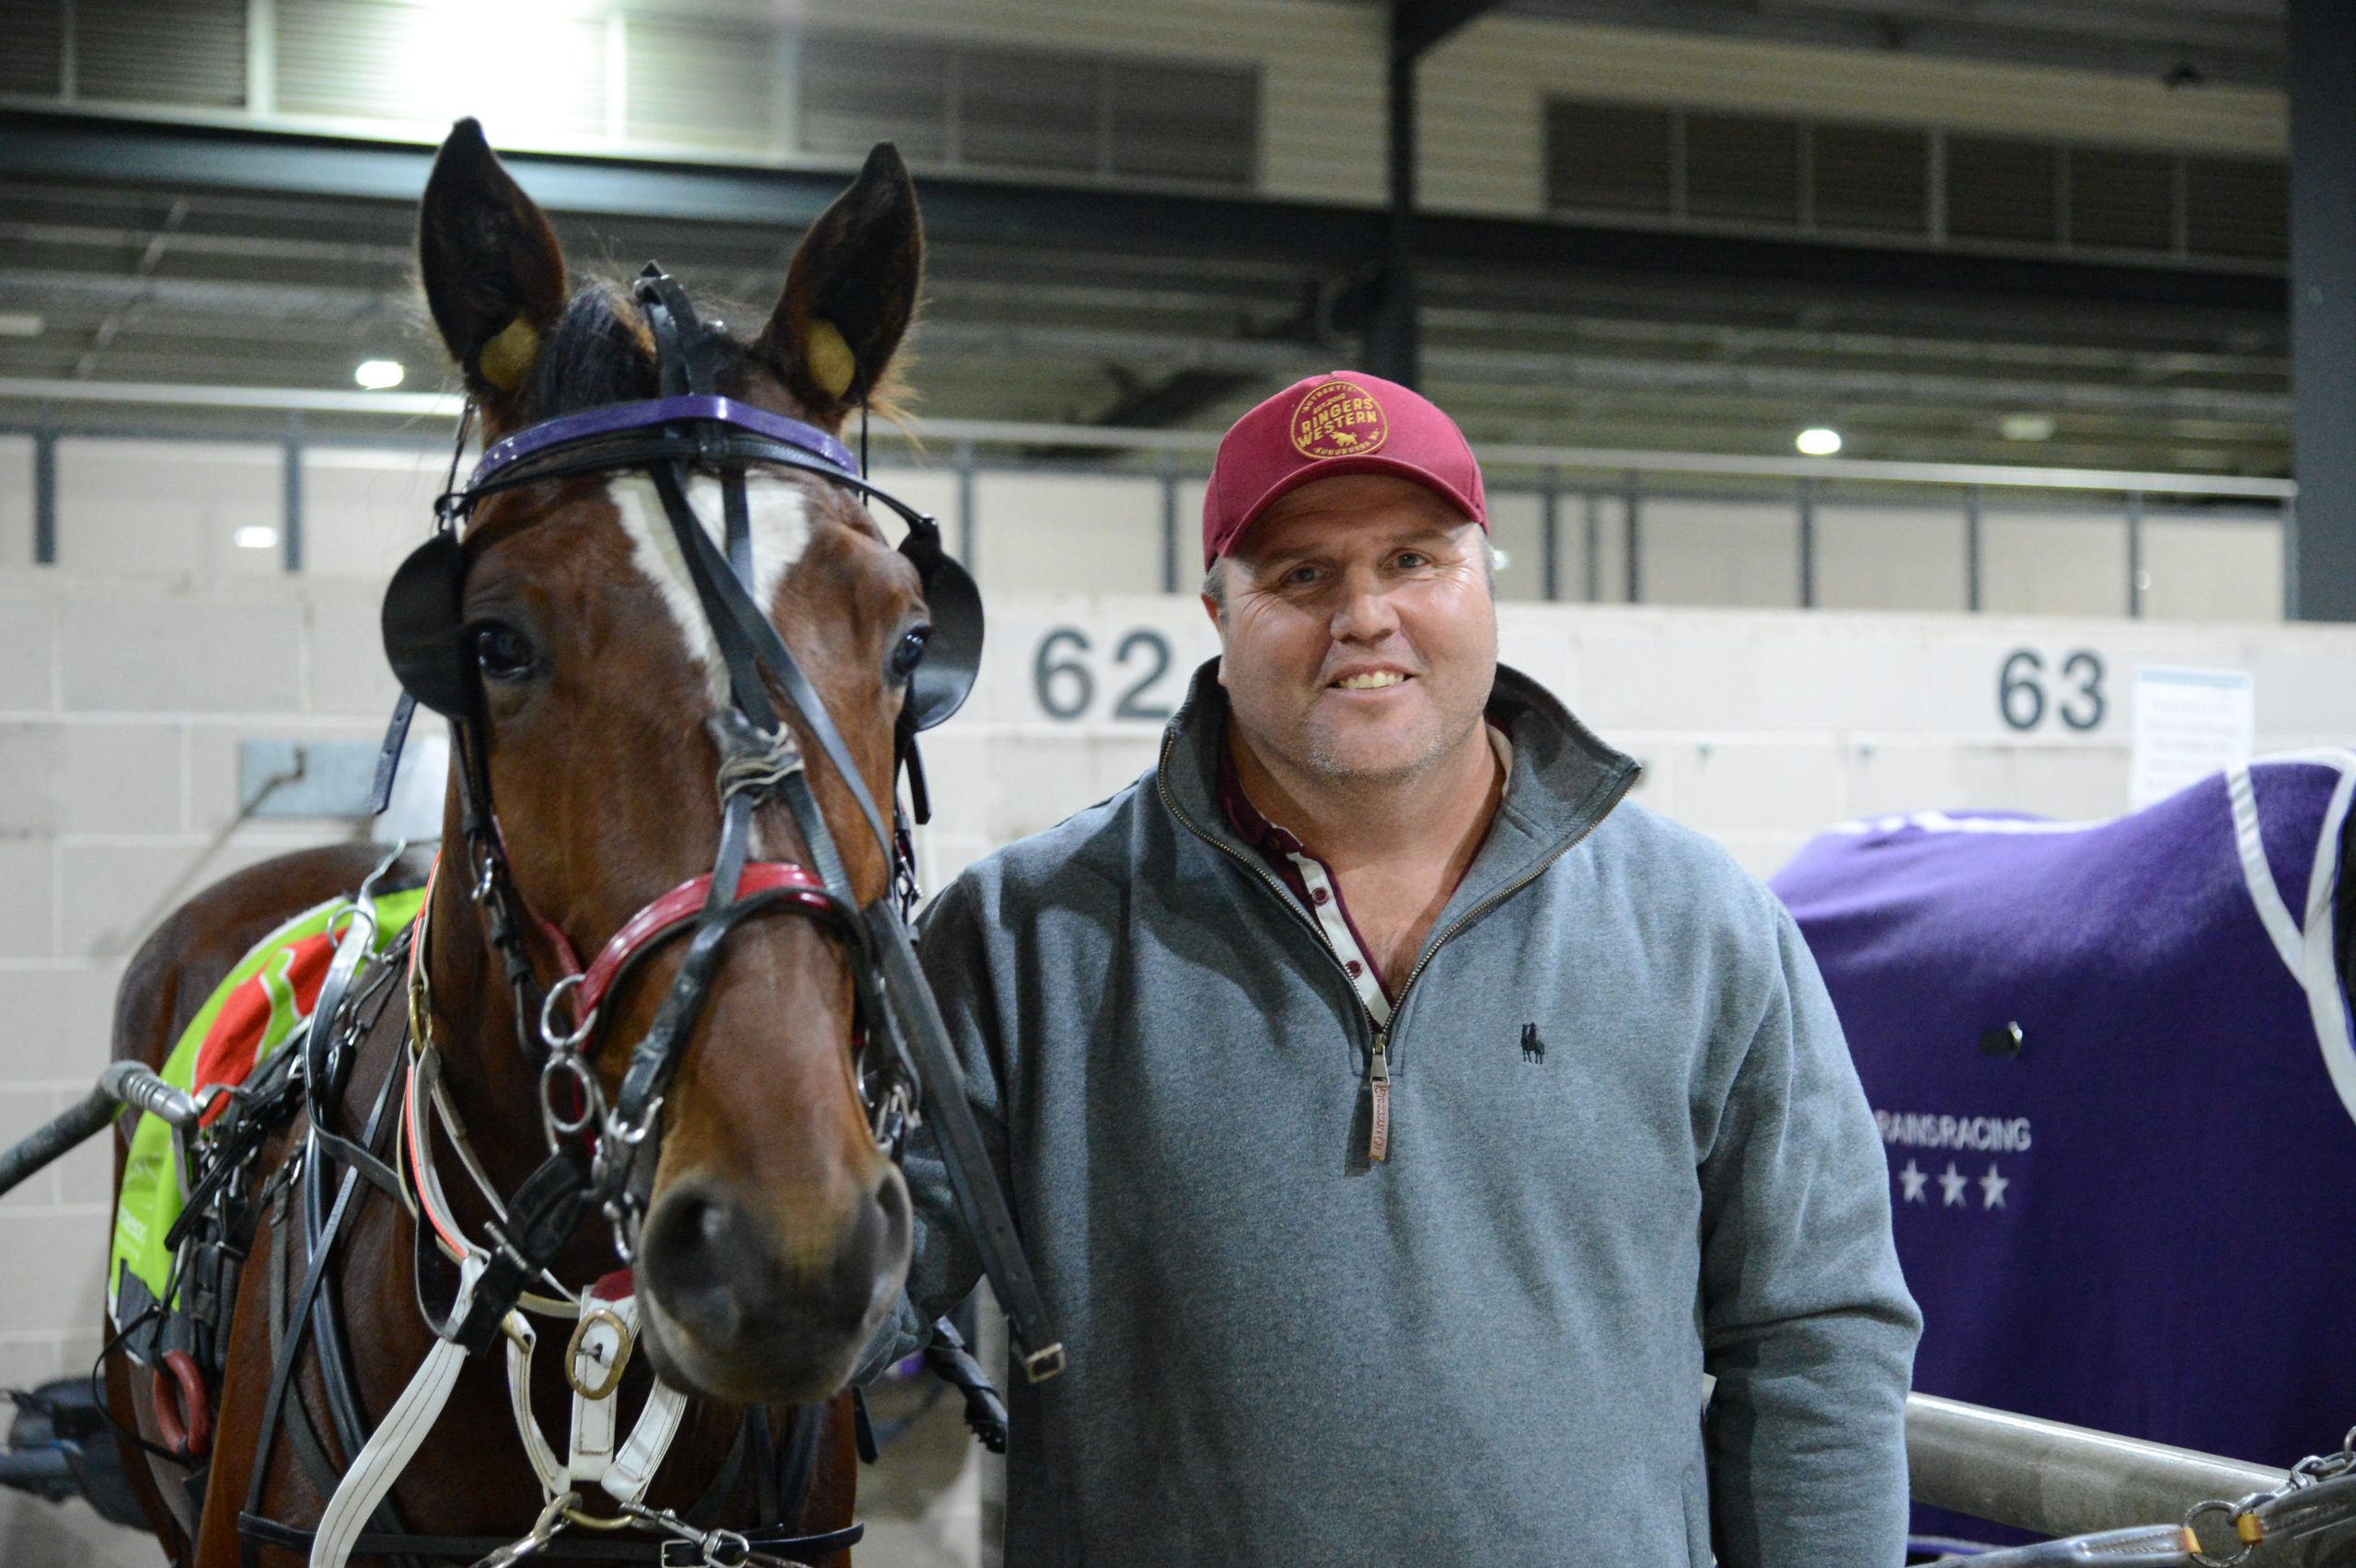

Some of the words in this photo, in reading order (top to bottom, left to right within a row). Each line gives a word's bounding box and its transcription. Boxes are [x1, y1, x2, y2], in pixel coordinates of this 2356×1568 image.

[1298, 411, 1378, 448] WESTERN
[1301, 398, 1374, 434] RINGERS
[1033, 627, 1171, 721] 62
[1998, 649, 2108, 730] 63
